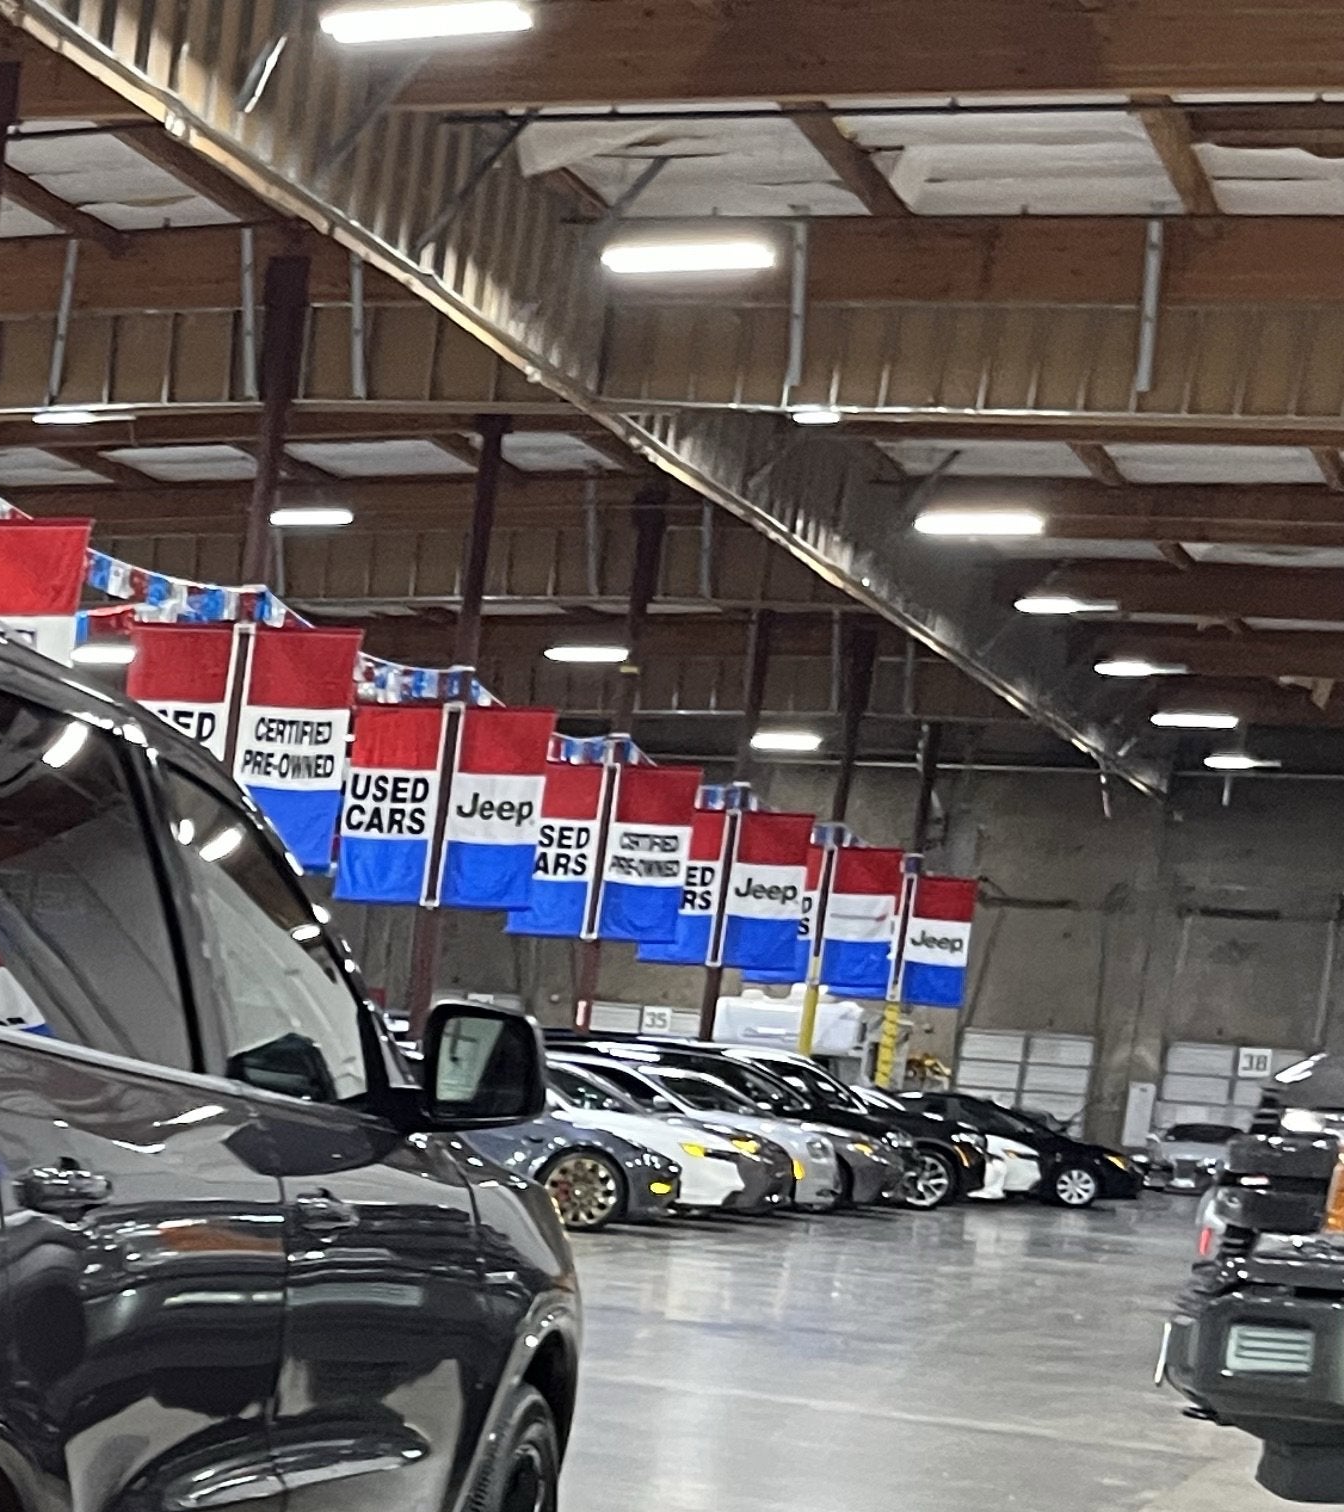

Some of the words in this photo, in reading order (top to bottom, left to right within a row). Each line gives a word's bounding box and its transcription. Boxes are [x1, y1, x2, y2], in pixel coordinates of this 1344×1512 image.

[255, 717, 332, 745] CERTIFIED
[241, 749, 334, 779] PRE-OWNED
[350, 774, 430, 803] USED
[345, 804, 426, 835] CARS
[456, 792, 534, 827] Jeep
[538, 824, 591, 849] SED
[533, 851, 588, 876] ARS
[734, 877, 798, 905] Jeep
[910, 930, 964, 954] Jeep
[645, 1011, 668, 1029] 35
